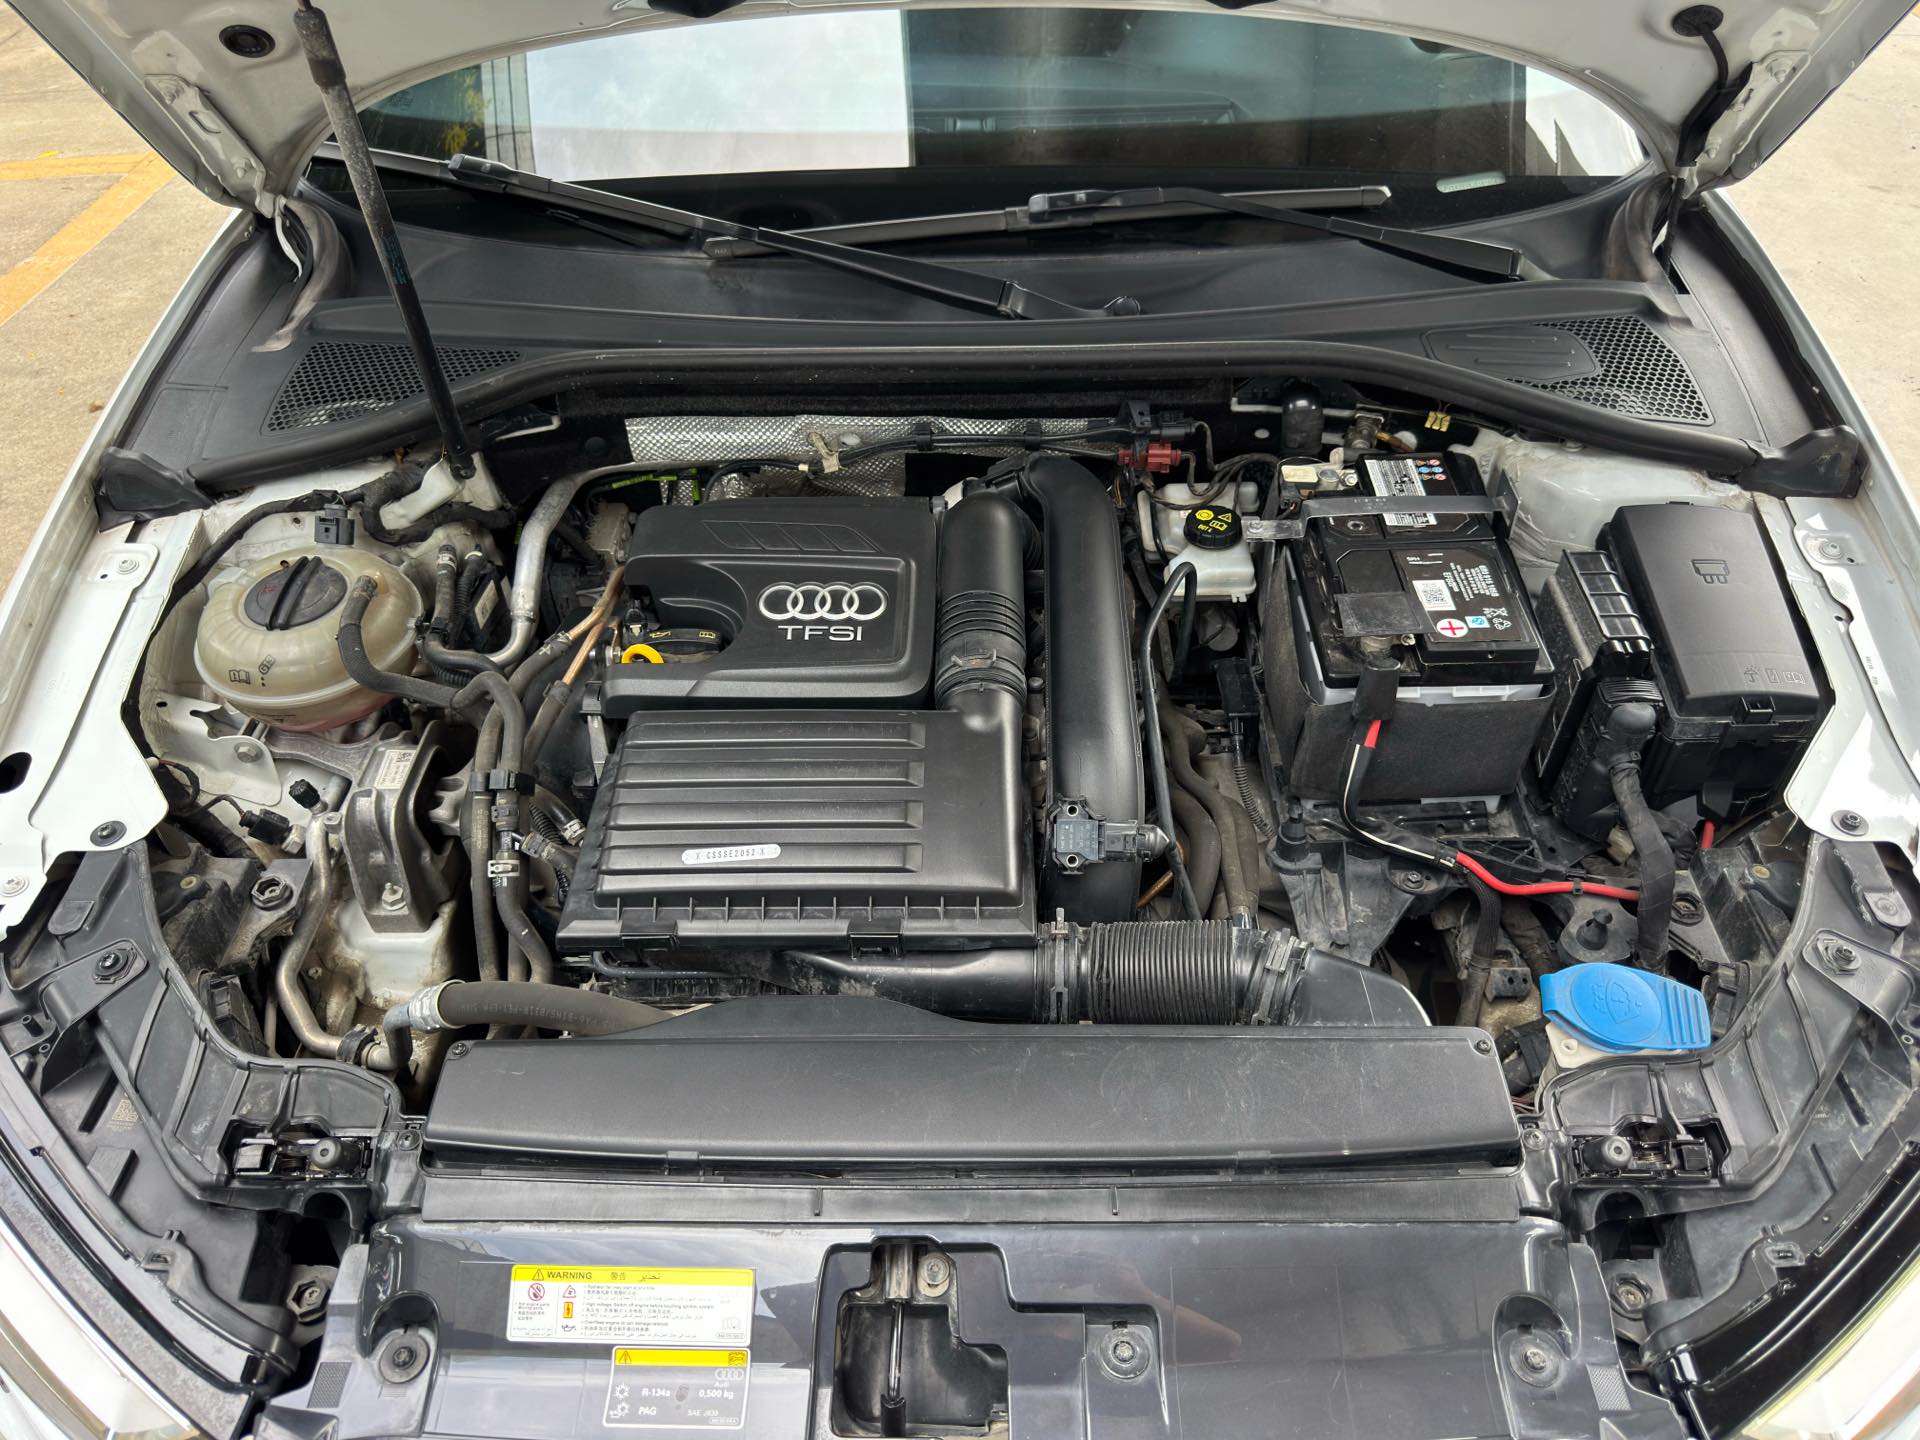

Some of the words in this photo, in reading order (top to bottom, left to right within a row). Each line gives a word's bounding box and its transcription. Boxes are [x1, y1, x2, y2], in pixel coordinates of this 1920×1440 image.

[778, 625, 863, 641] TFSI
[547, 1271, 592, 1280] WARNING
[640, 1387, 671, 1397] R-134a
[723, 1389, 734, 1400] kg
[638, 1405, 657, 1416] PAG
